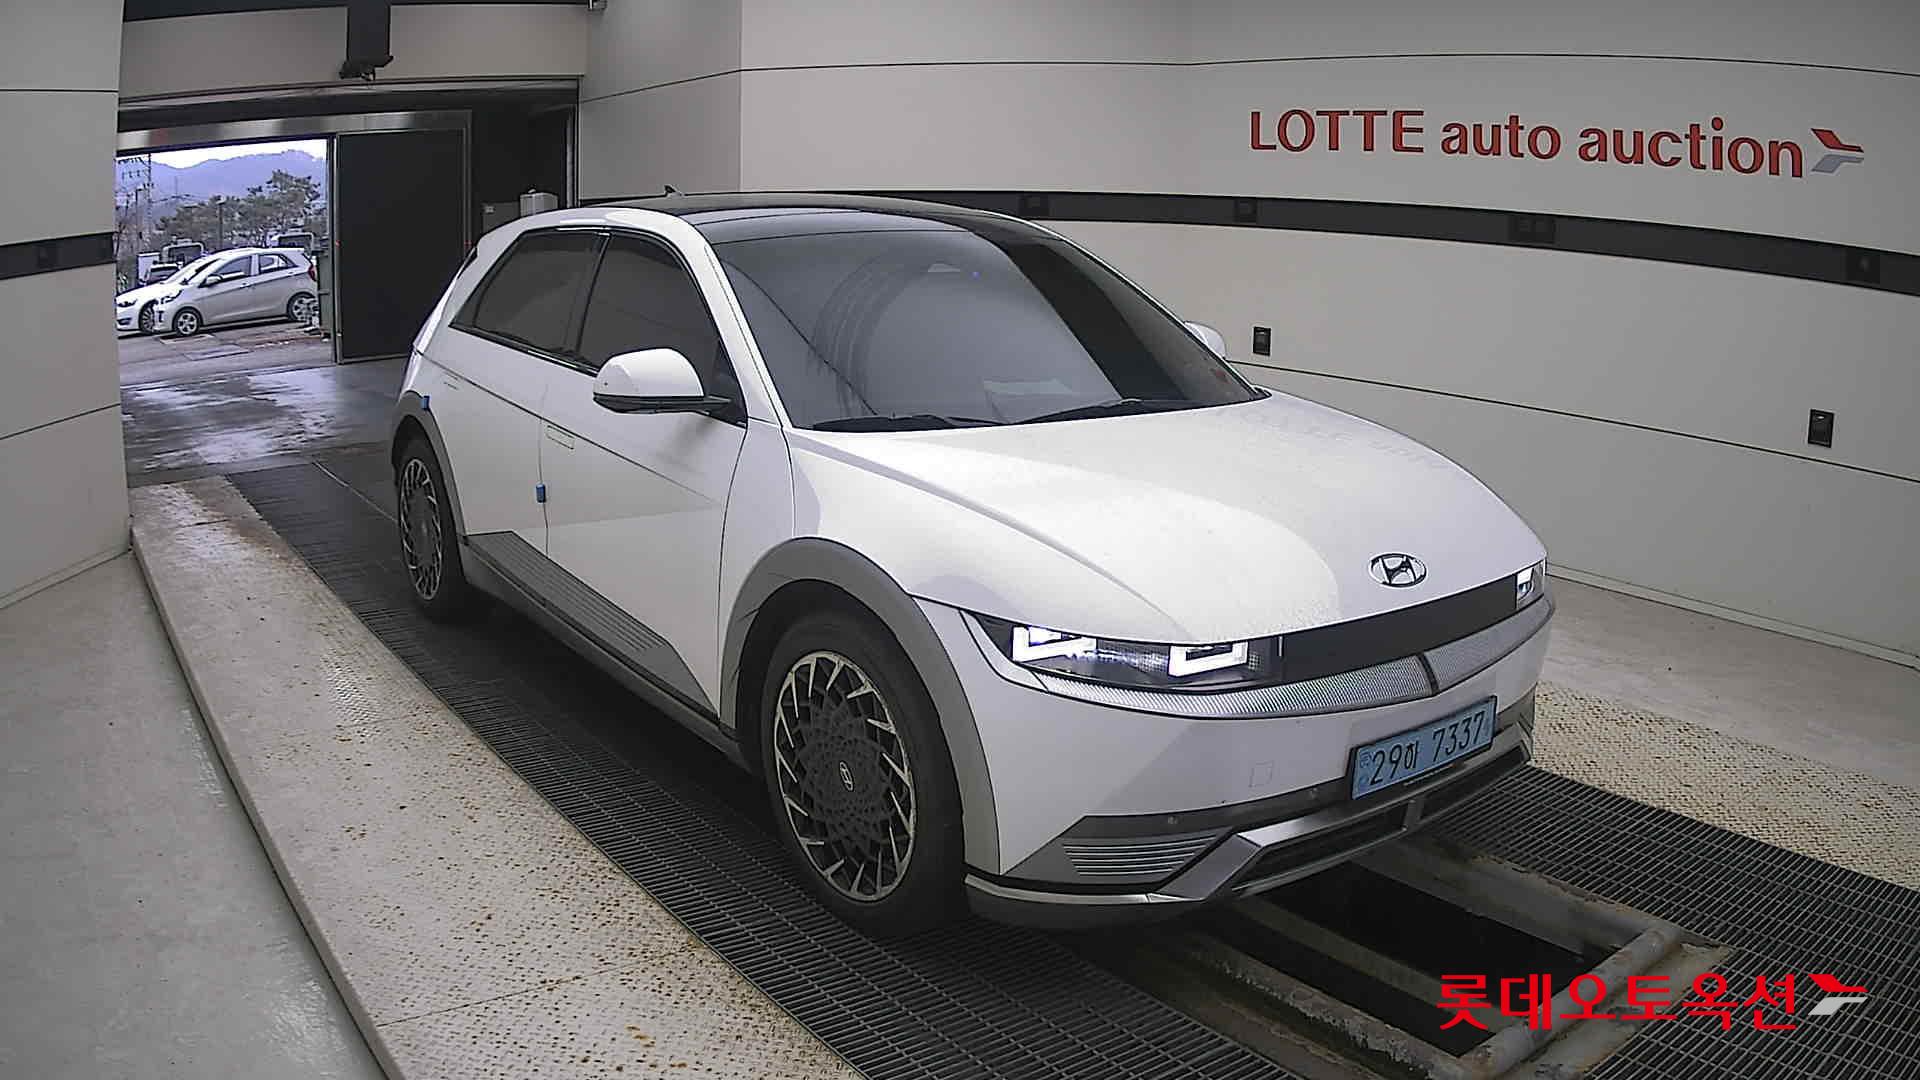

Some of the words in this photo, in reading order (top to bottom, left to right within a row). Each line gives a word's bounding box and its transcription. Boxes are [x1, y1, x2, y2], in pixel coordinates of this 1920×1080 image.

[1251, 109, 1425, 153] LOTTE
[1441, 115, 1561, 159] auto
[1578, 117, 1803, 178] auction
[1432, 711, 1485, 762] 7337
